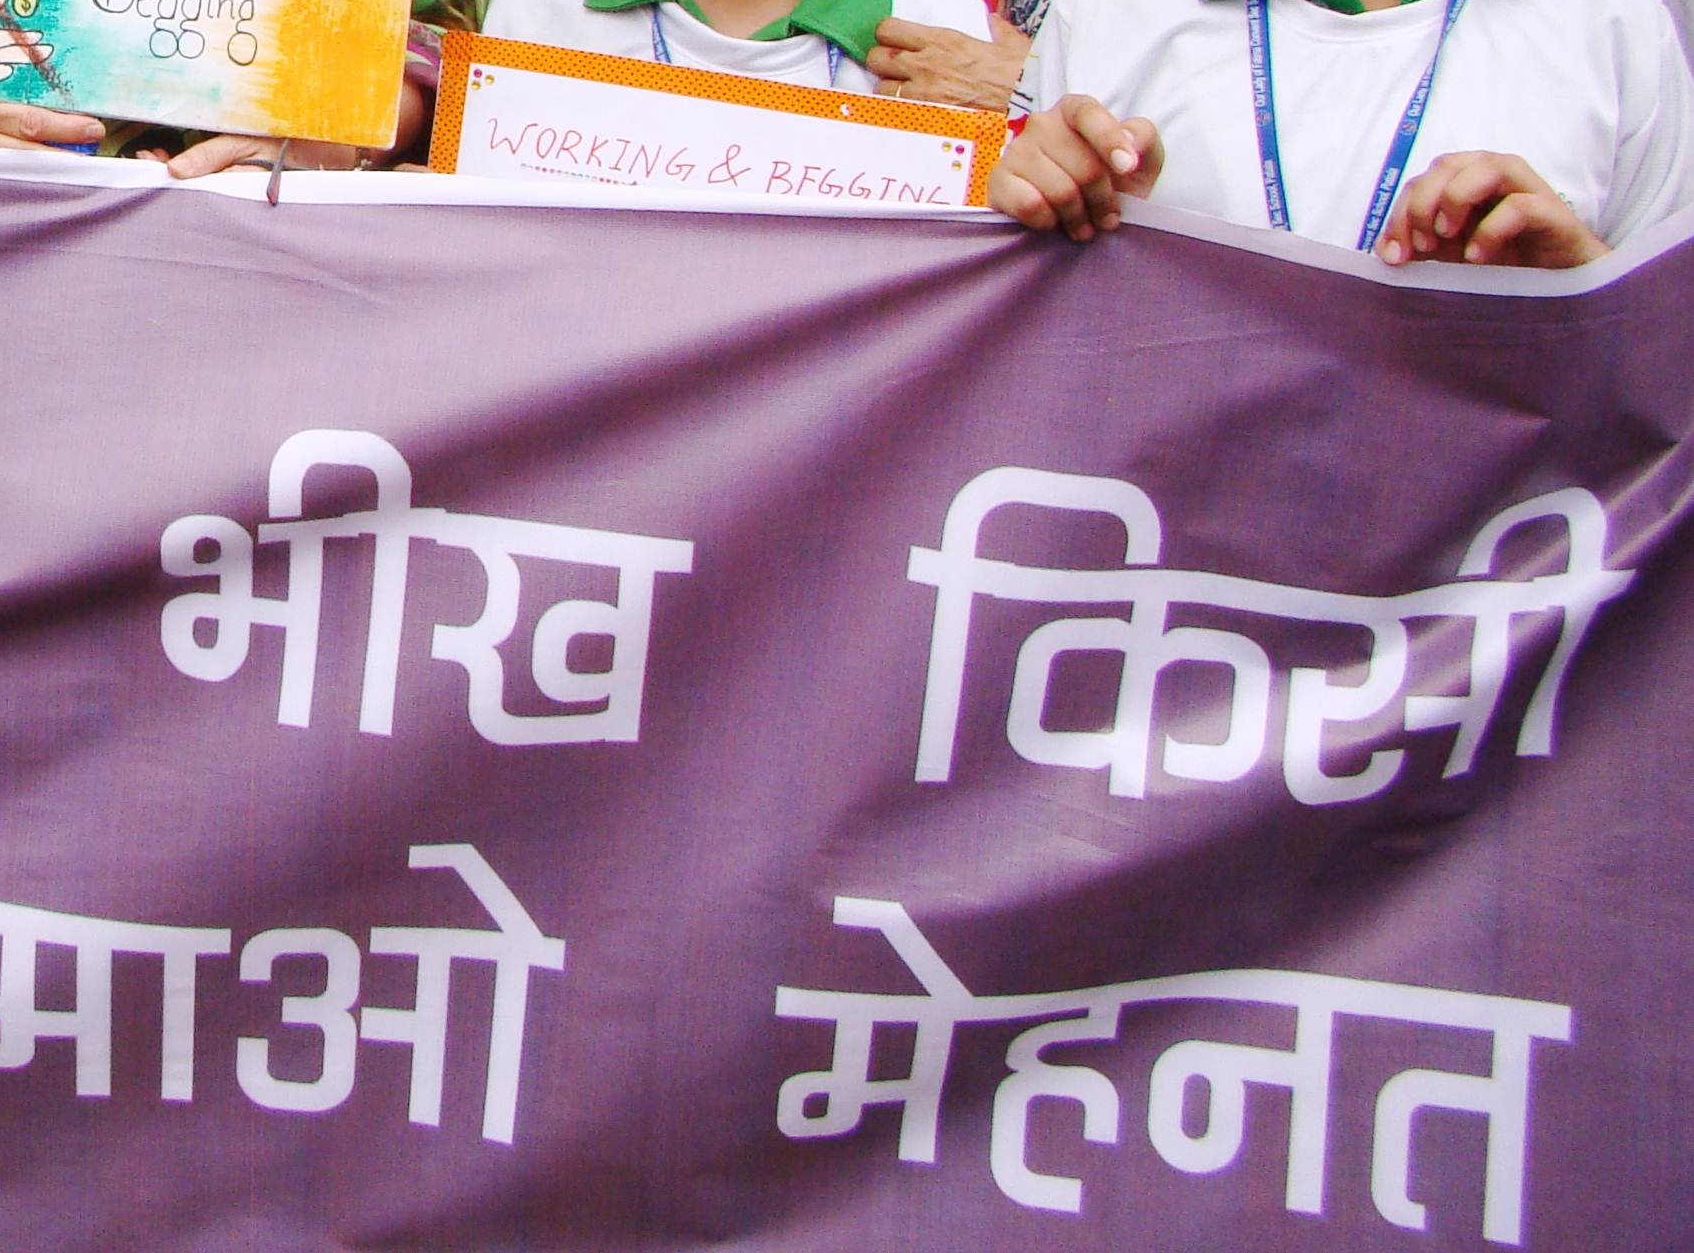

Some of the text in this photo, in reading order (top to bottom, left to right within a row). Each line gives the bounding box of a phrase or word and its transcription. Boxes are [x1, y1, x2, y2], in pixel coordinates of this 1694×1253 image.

[487, 117, 697, 182] WORKING
[707, 142, 753, 186] &
[160, 428, 696, 747] भीख
[906, 465, 1637, 805] किसी
[774, 895, 1573, 1246] मेहनत
